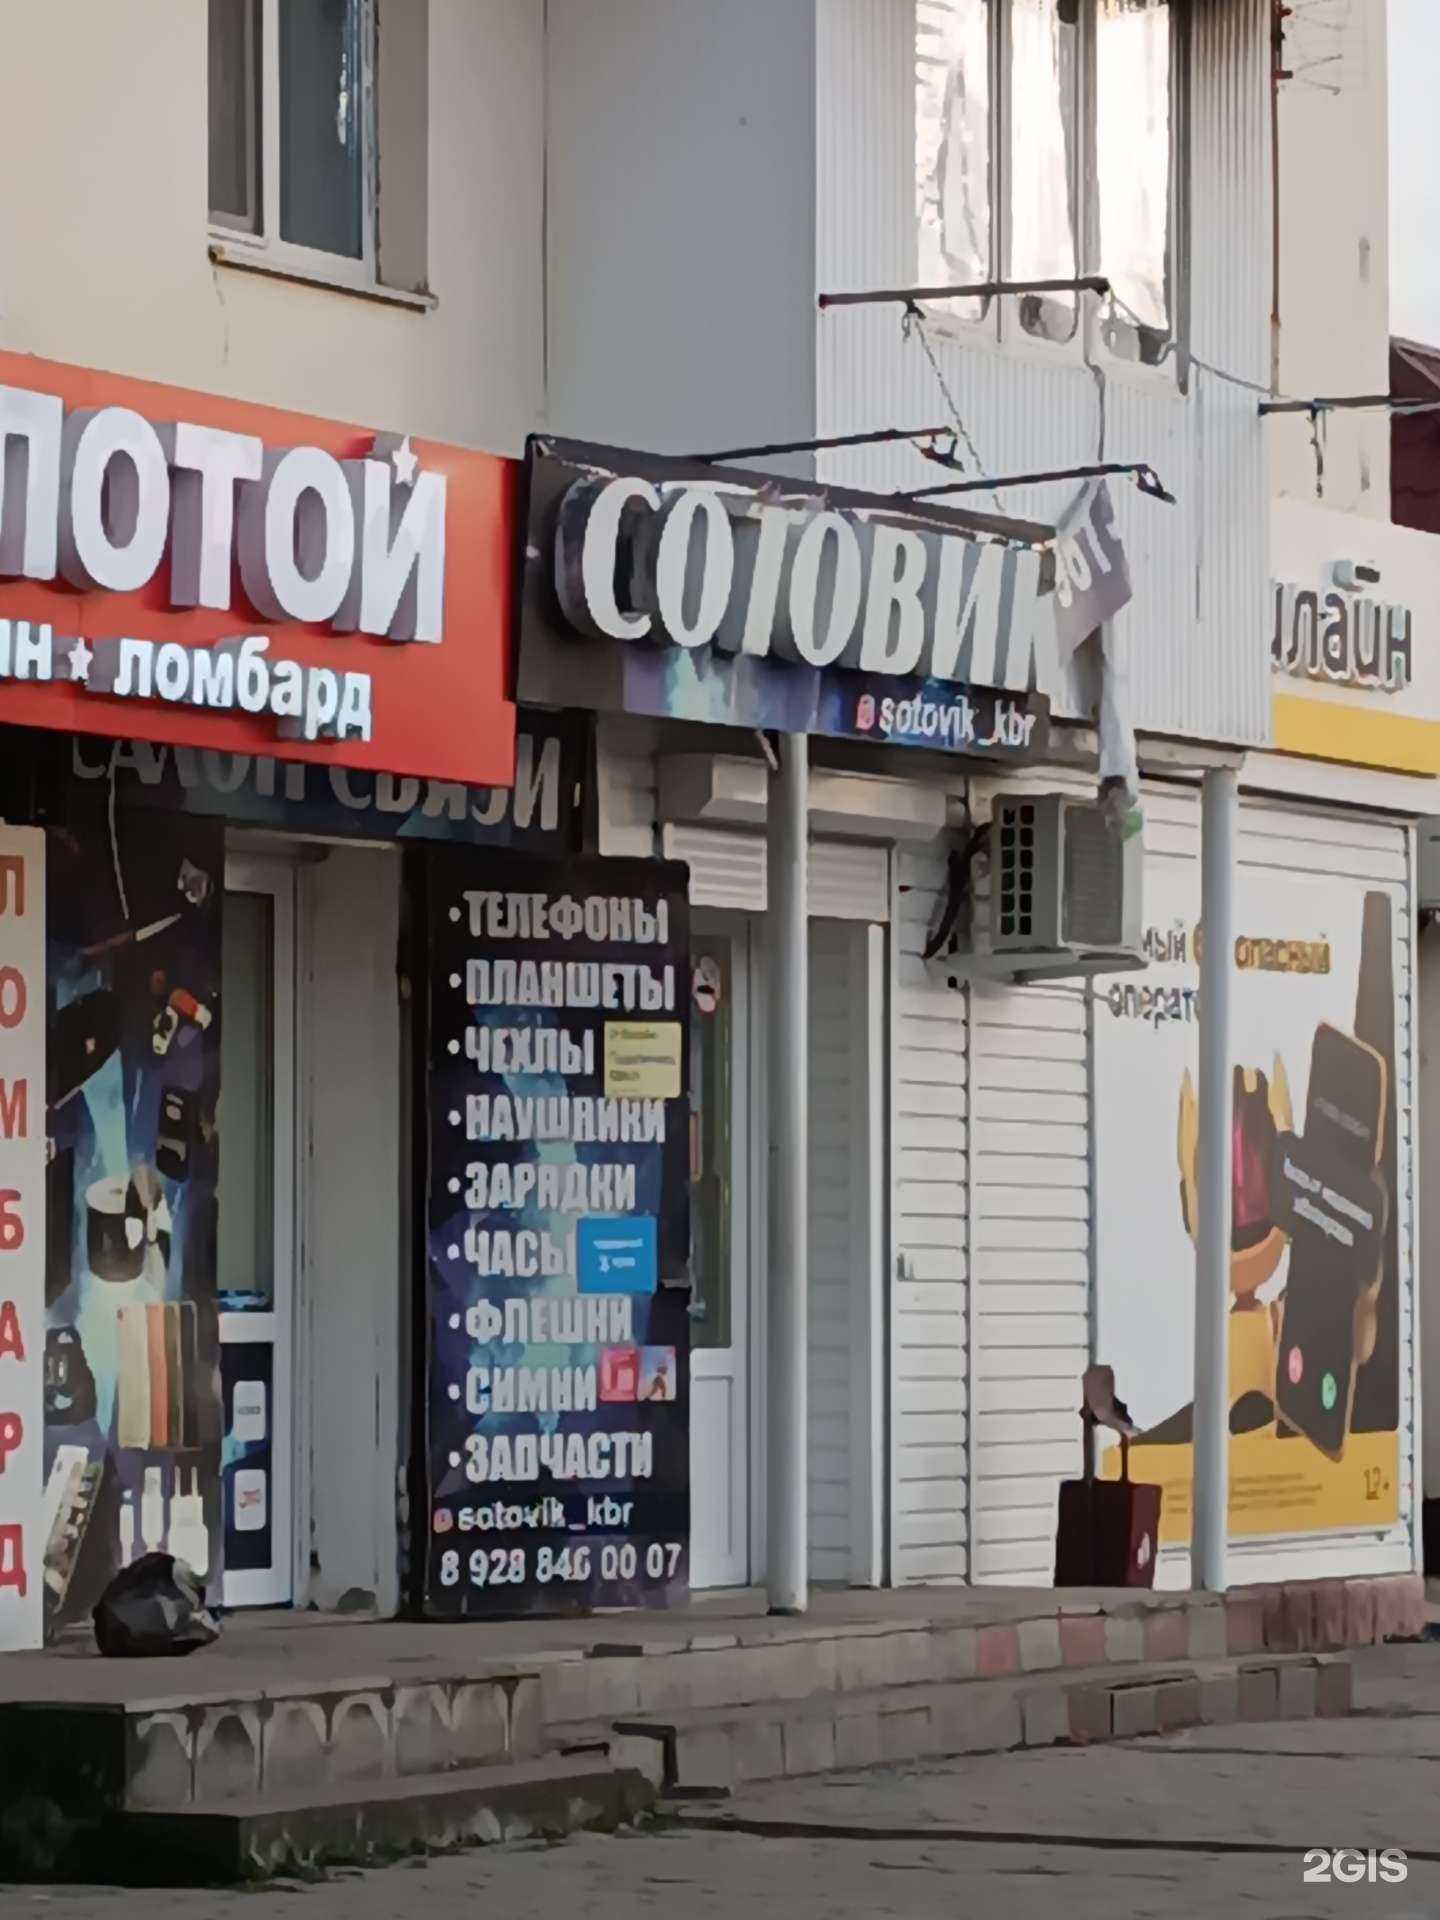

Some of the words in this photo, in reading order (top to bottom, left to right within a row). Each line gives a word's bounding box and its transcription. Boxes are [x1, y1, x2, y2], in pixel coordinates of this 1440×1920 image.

[581, 476, 1064, 697] СОТОВИК
[113, 636, 372, 742] ломбард
[879, 691, 1037, 748] sotovik_kbr
[463, 890, 669, 944] ТЕЛЕФОНЫ
[465, 959, 675, 1012] ПЛАНШЕТЫ
[464, 1025, 595, 1076] ЧЕХЛЫ
[465, 1094, 666, 1144] НАУШНИКИ
[464, 1161, 636, 1213] ЗАРЯДКИ
[464, 1228, 577, 1277] ЧАСЫ
[465, 1430, 653, 1482] ЗАПЧАСТИ
[458, 1495, 634, 1531] sotovik_kbr
[440, 1550, 460, 1587] 8
[469, 1549, 526, 1587] 928
[601, 1543, 638, 1580] 00
[646, 1542, 683, 1579] 07
